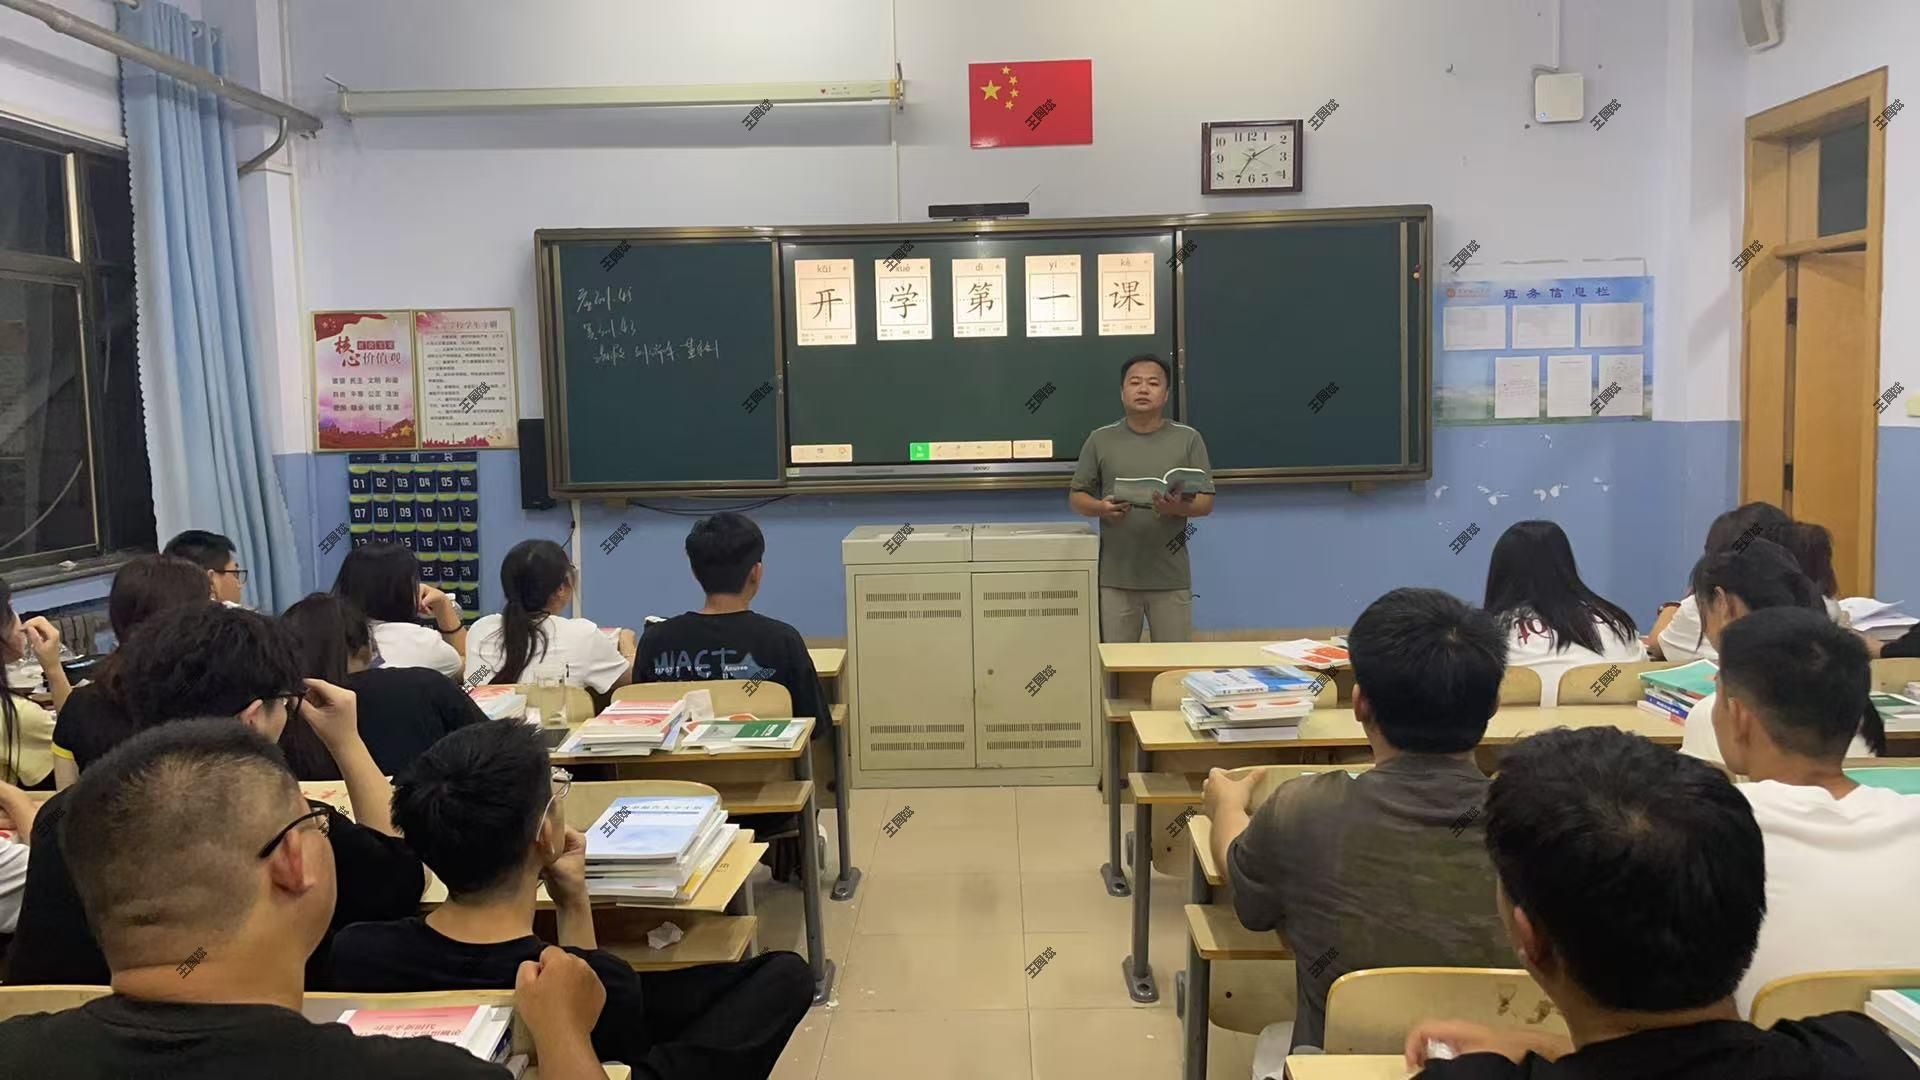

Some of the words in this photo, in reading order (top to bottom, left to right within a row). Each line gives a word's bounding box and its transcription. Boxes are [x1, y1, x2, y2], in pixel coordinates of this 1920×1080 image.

[1215, 136, 1226, 148] 10
[1234, 132, 1242, 142] 11
[1247, 132, 1258, 142] 12
[1280, 134, 1288, 144] 2
[1216, 154, 1224, 164] 9
[1280, 152, 1287, 162] 3
[1216, 172, 1224, 181] 8
[1234, 174, 1242, 184] 7
[1248, 174, 1256, 184] 6
[1261, 174, 1268, 183] 5
[1504, 286, 1610, 299] 班务信息栏
[363, 352, 401, 366] 价值观
[353, 479, 365, 489] 01
[376, 477, 388, 488] 02
[397, 477, 408, 488] 03
[419, 477, 430, 488] 04
[441, 476, 453, 487] 05
[460, 476, 471, 487] 06
[354, 508, 366, 518] 07
[377, 507, 389, 518] 08
[400, 507, 411, 518] 09
[420, 507, 433, 518] 10
[441, 507, 453, 517] 11
[460, 506, 471, 517] 12
[421, 537, 433, 547] 16
[442, 536, 453, 546] 17
[460, 536, 472, 547] 18
[422, 566, 434, 577] 22
[442, 566, 454, 577] 23
[460, 566, 471, 577] 24
